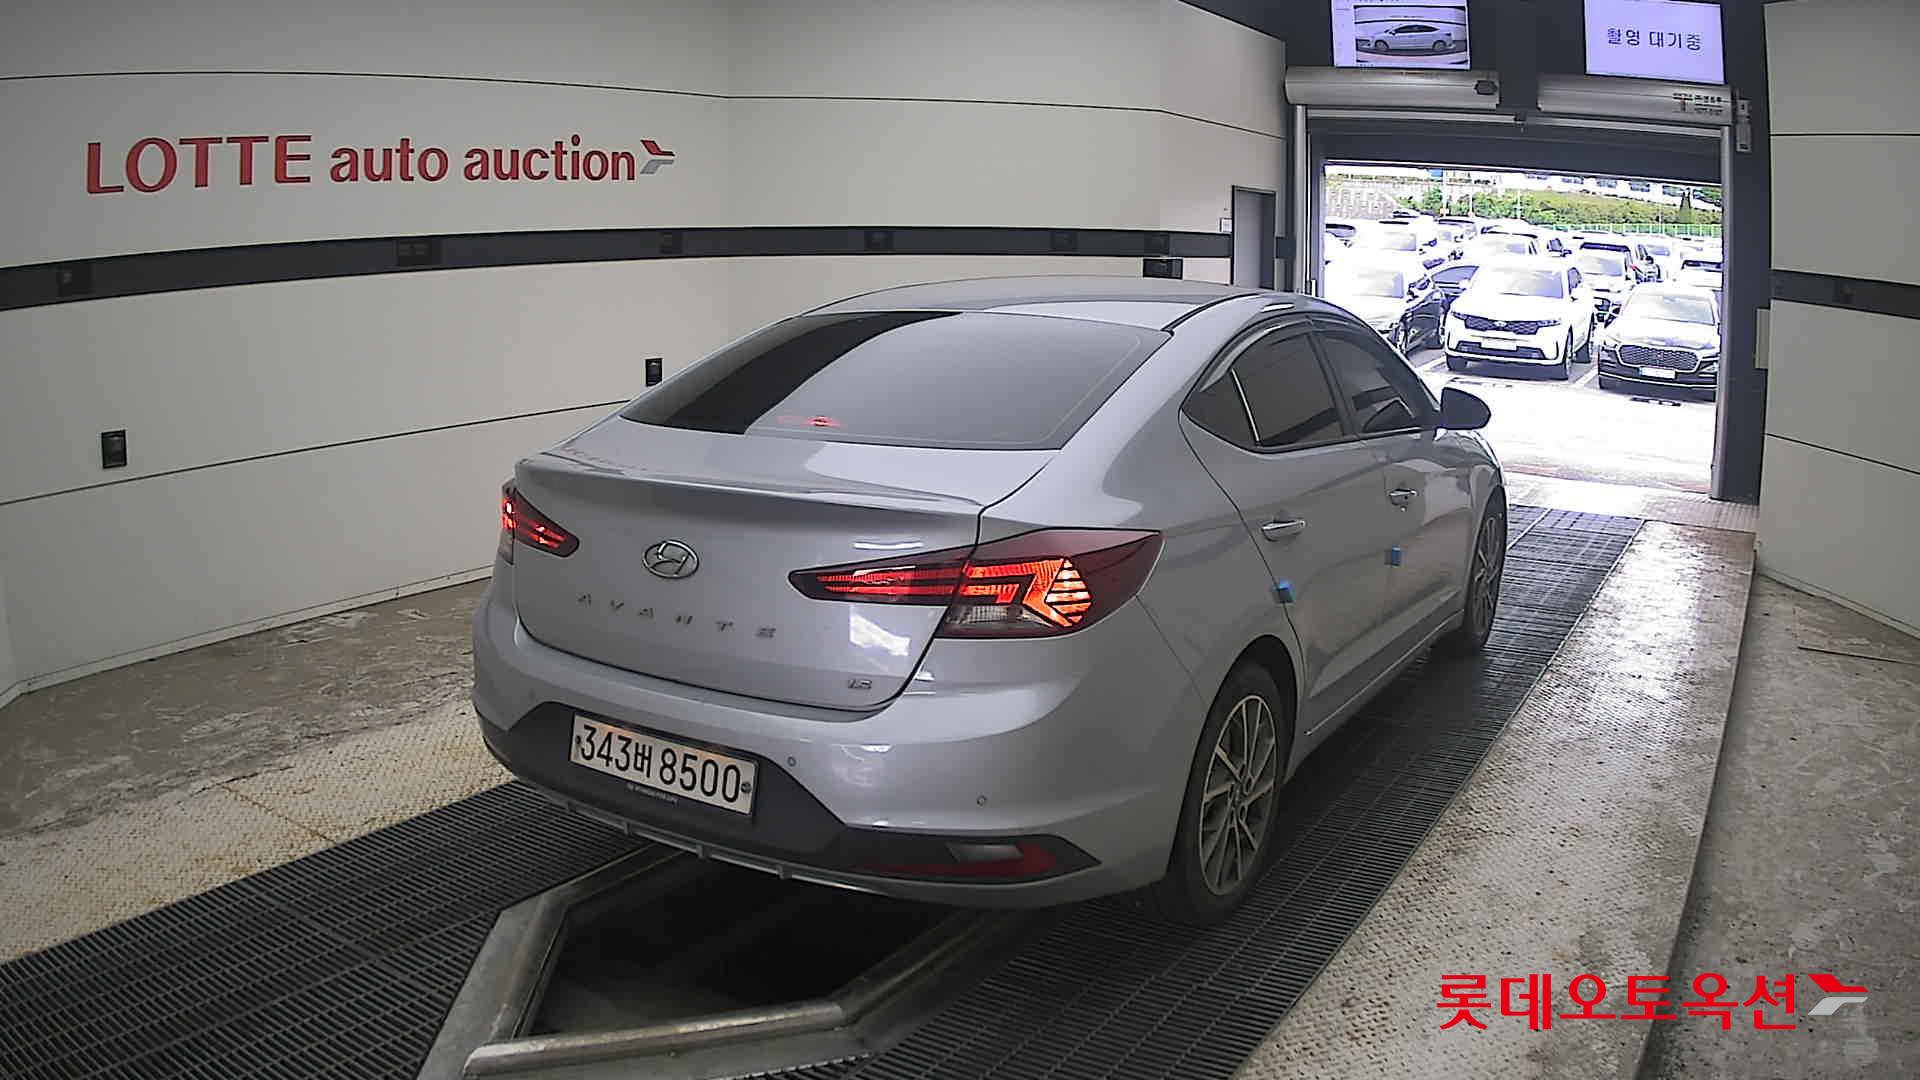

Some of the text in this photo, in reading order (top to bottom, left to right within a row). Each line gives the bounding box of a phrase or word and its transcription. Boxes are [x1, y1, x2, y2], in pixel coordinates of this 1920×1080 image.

[1648, 31, 1702, 51] 대기중
[86, 133, 636, 195] LOTTE auto auction
[577, 593, 777, 639] AVANTE
[659, 748, 742, 804] 8500
